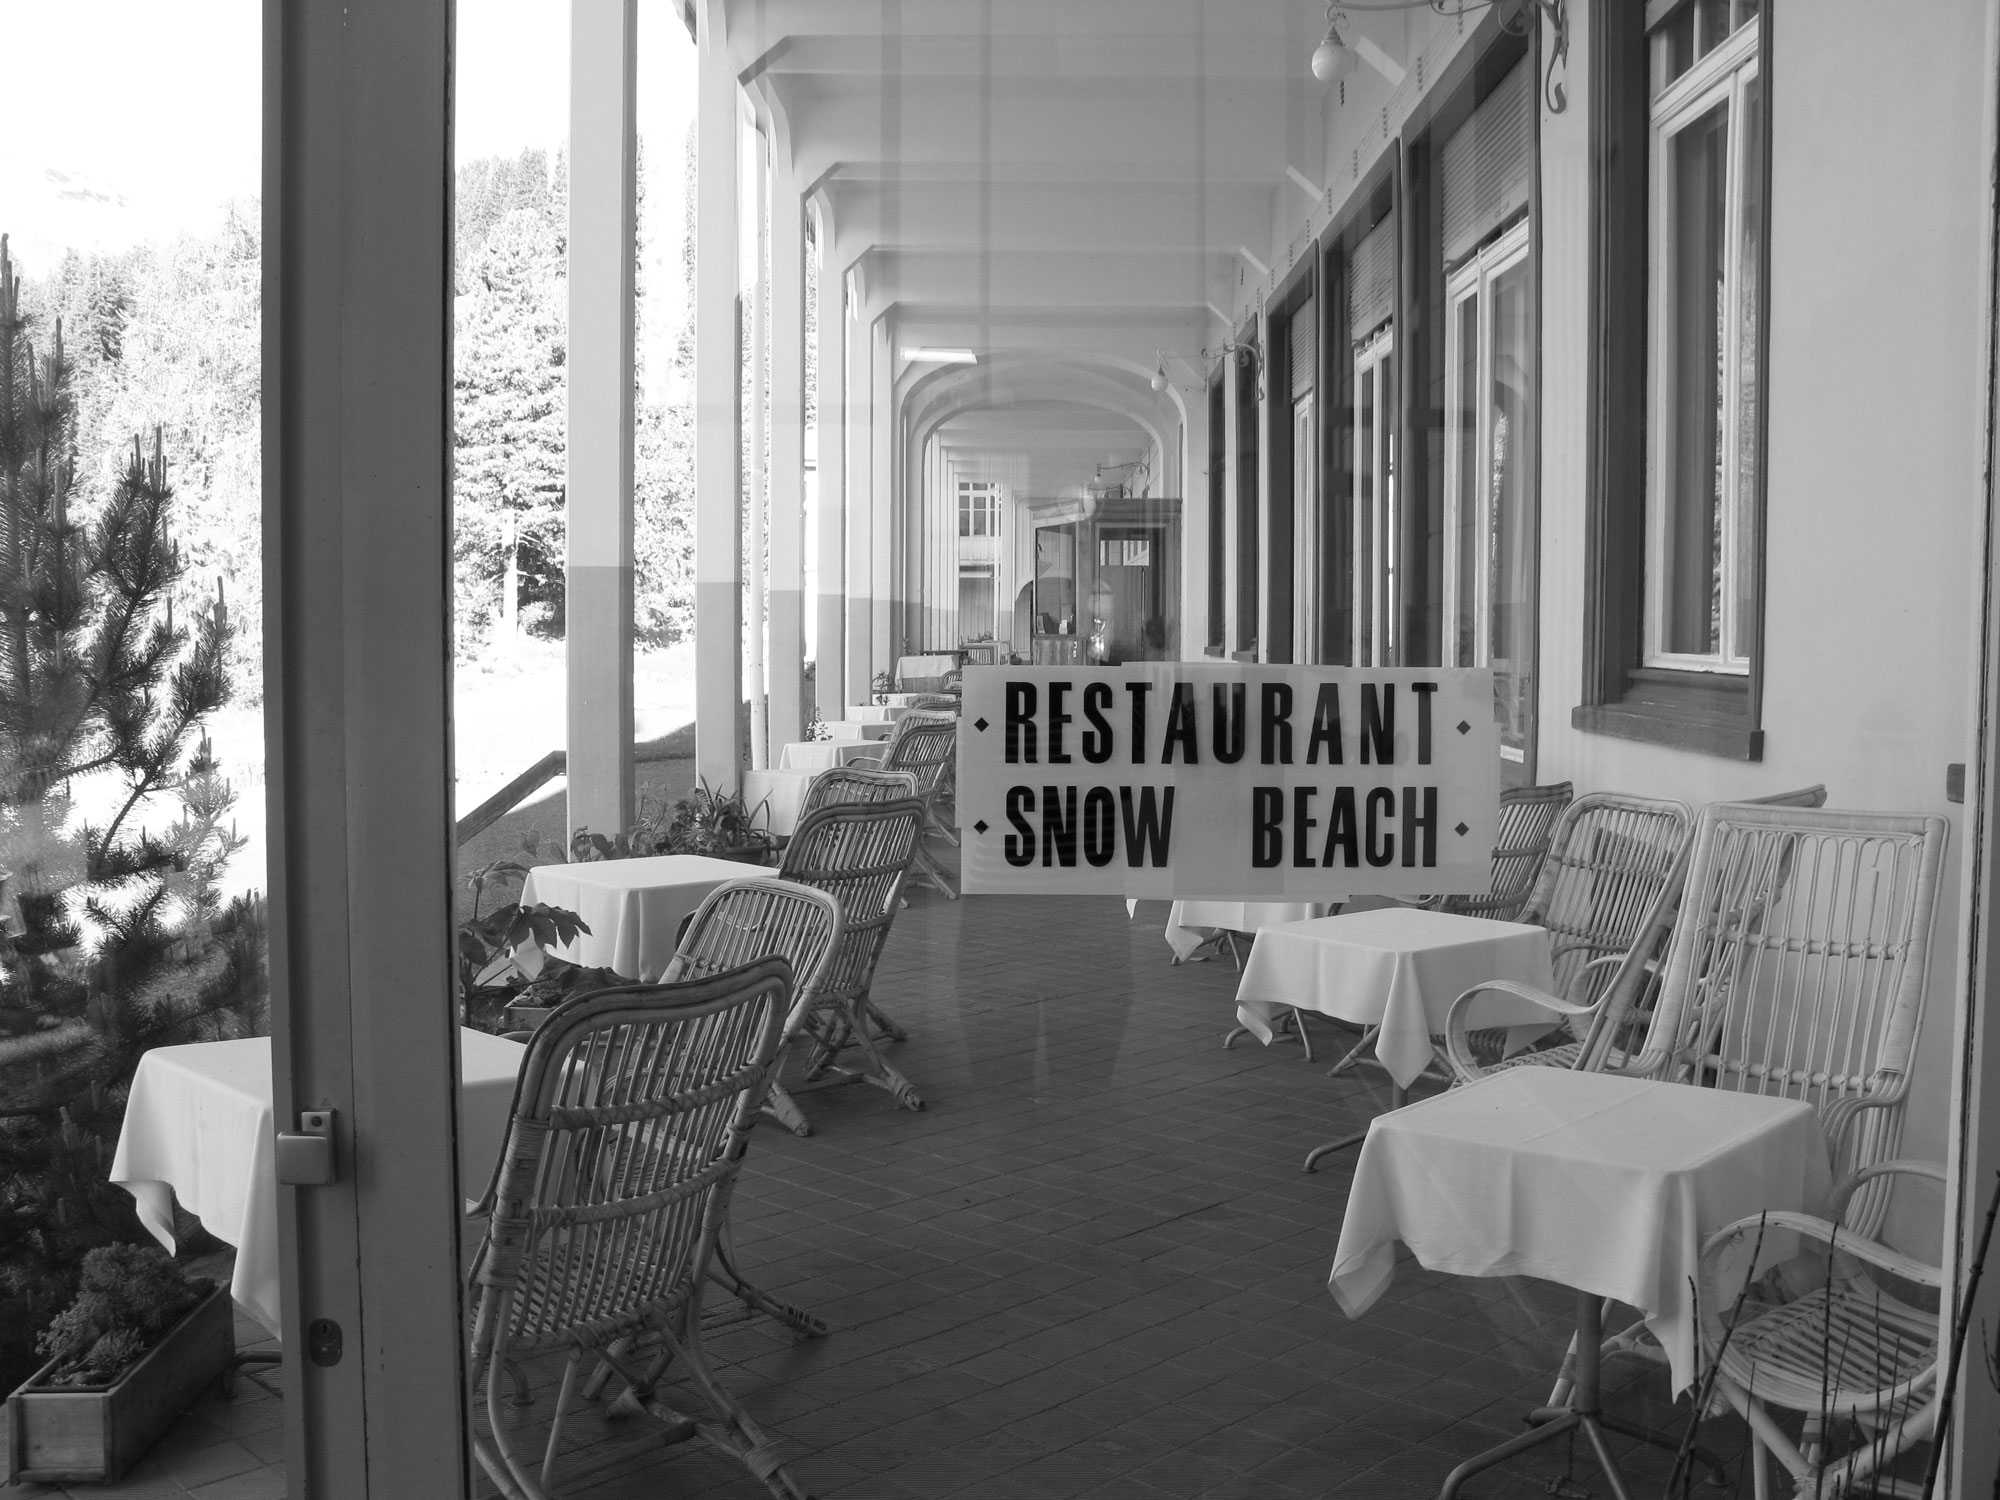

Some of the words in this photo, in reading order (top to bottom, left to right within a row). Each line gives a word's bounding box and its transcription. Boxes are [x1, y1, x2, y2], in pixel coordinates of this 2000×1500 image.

[1005, 682, 1438, 764] RESTAURANT
[1005, 786, 1175, 868] SNOW
[1252, 786, 1438, 868] BEACH
